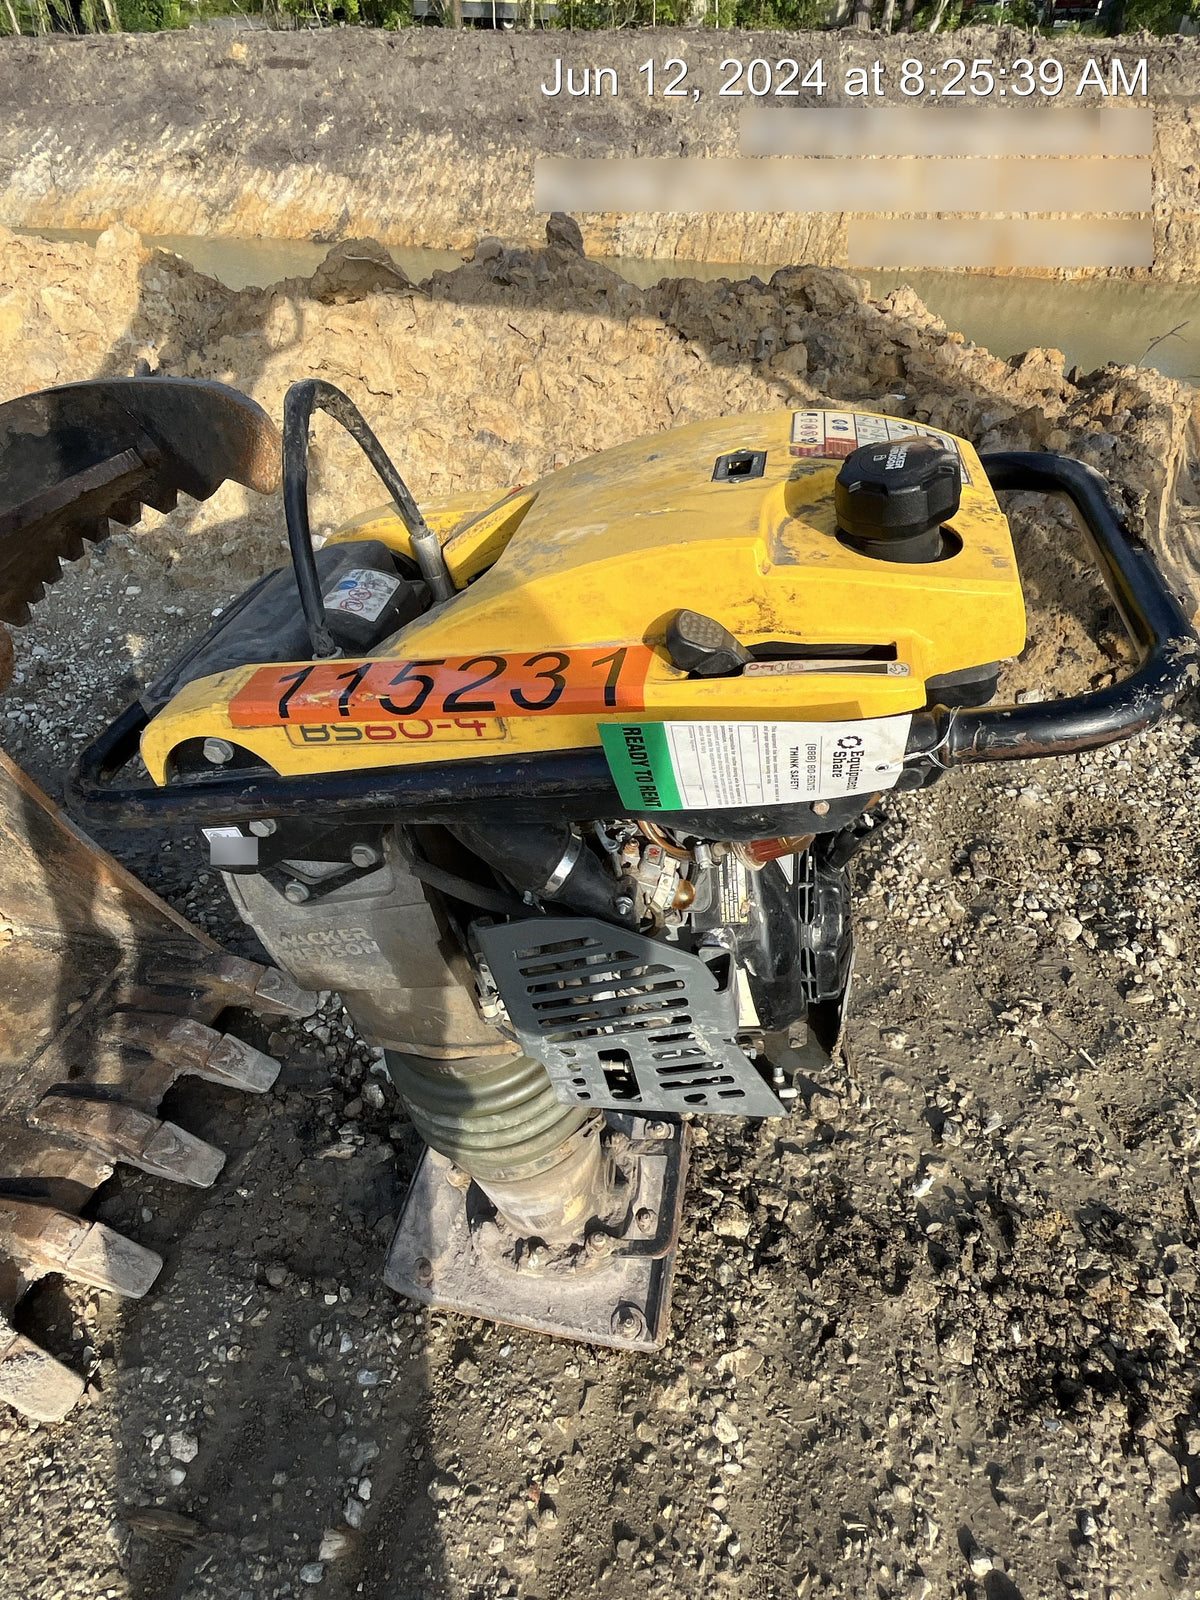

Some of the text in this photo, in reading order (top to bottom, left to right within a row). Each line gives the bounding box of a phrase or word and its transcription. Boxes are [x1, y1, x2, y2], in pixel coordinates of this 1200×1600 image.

[278, 646, 628, 719] 115231
[622, 727, 662, 808] READY TO RENT
[789, 746, 800, 791] THINK SAFETY
[832, 751, 847, 778] Share
[846, 750, 865, 790] Equipment
